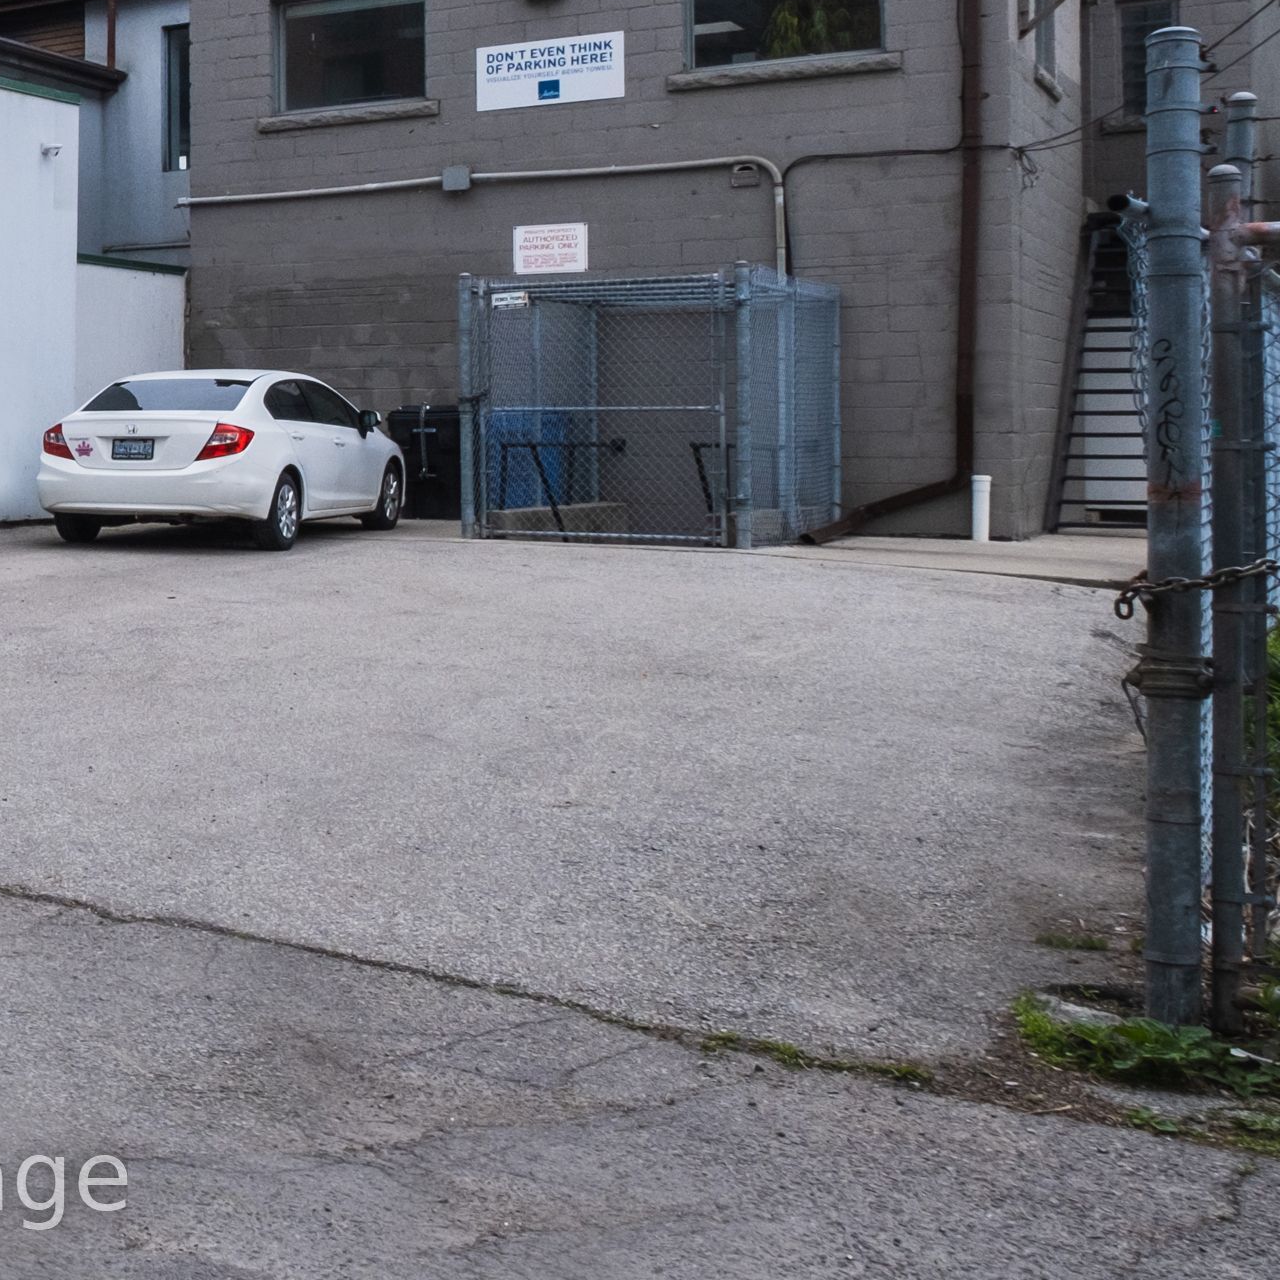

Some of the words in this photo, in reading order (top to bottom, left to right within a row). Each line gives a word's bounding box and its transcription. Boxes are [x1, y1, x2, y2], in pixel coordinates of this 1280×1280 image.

[486, 49, 526, 64] DON'T
[530, 46, 565, 58] EVEN
[569, 40, 613, 54] THINK
[486, 64, 502, 75] OF
[507, 57, 566, 73] PARKING
[571, 51, 613, 65] HERE!
[523, 70, 559, 80] YOURSELF
[523, 234, 578, 243] AUTHORIZED
[519, 243, 554, 251] PARKING
[558, 242, 579, 250] ONLY
